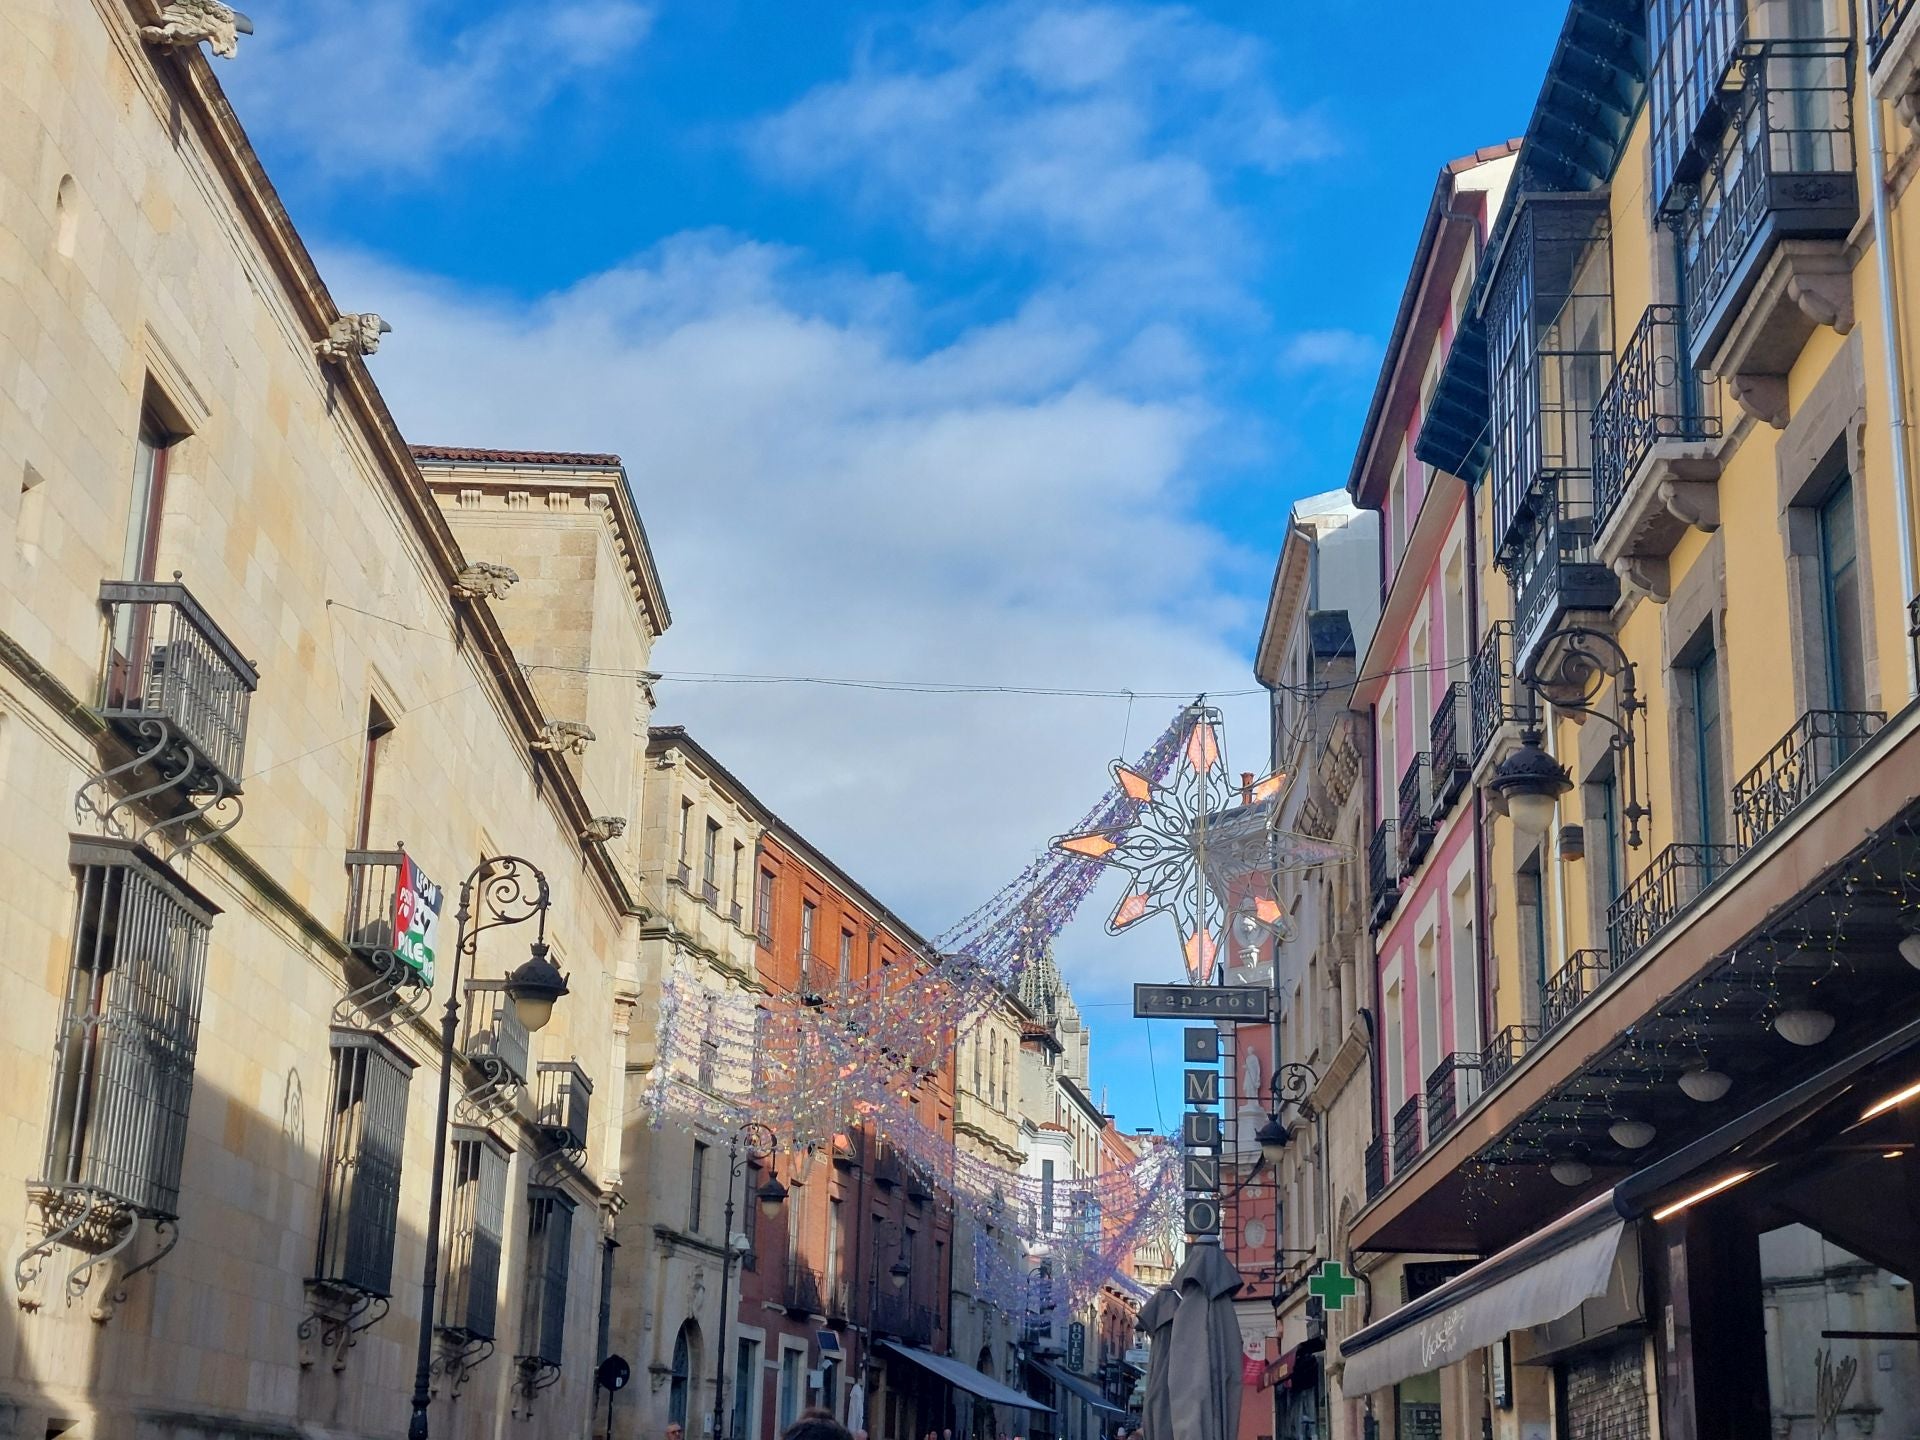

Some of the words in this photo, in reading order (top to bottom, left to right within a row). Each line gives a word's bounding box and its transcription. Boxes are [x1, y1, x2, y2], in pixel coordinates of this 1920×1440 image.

[1150, 994, 1256, 1009] zapatos
[1187, 1073, 1217, 1231] MUÑO
[1071, 1324, 1081, 1364] HOTEL
